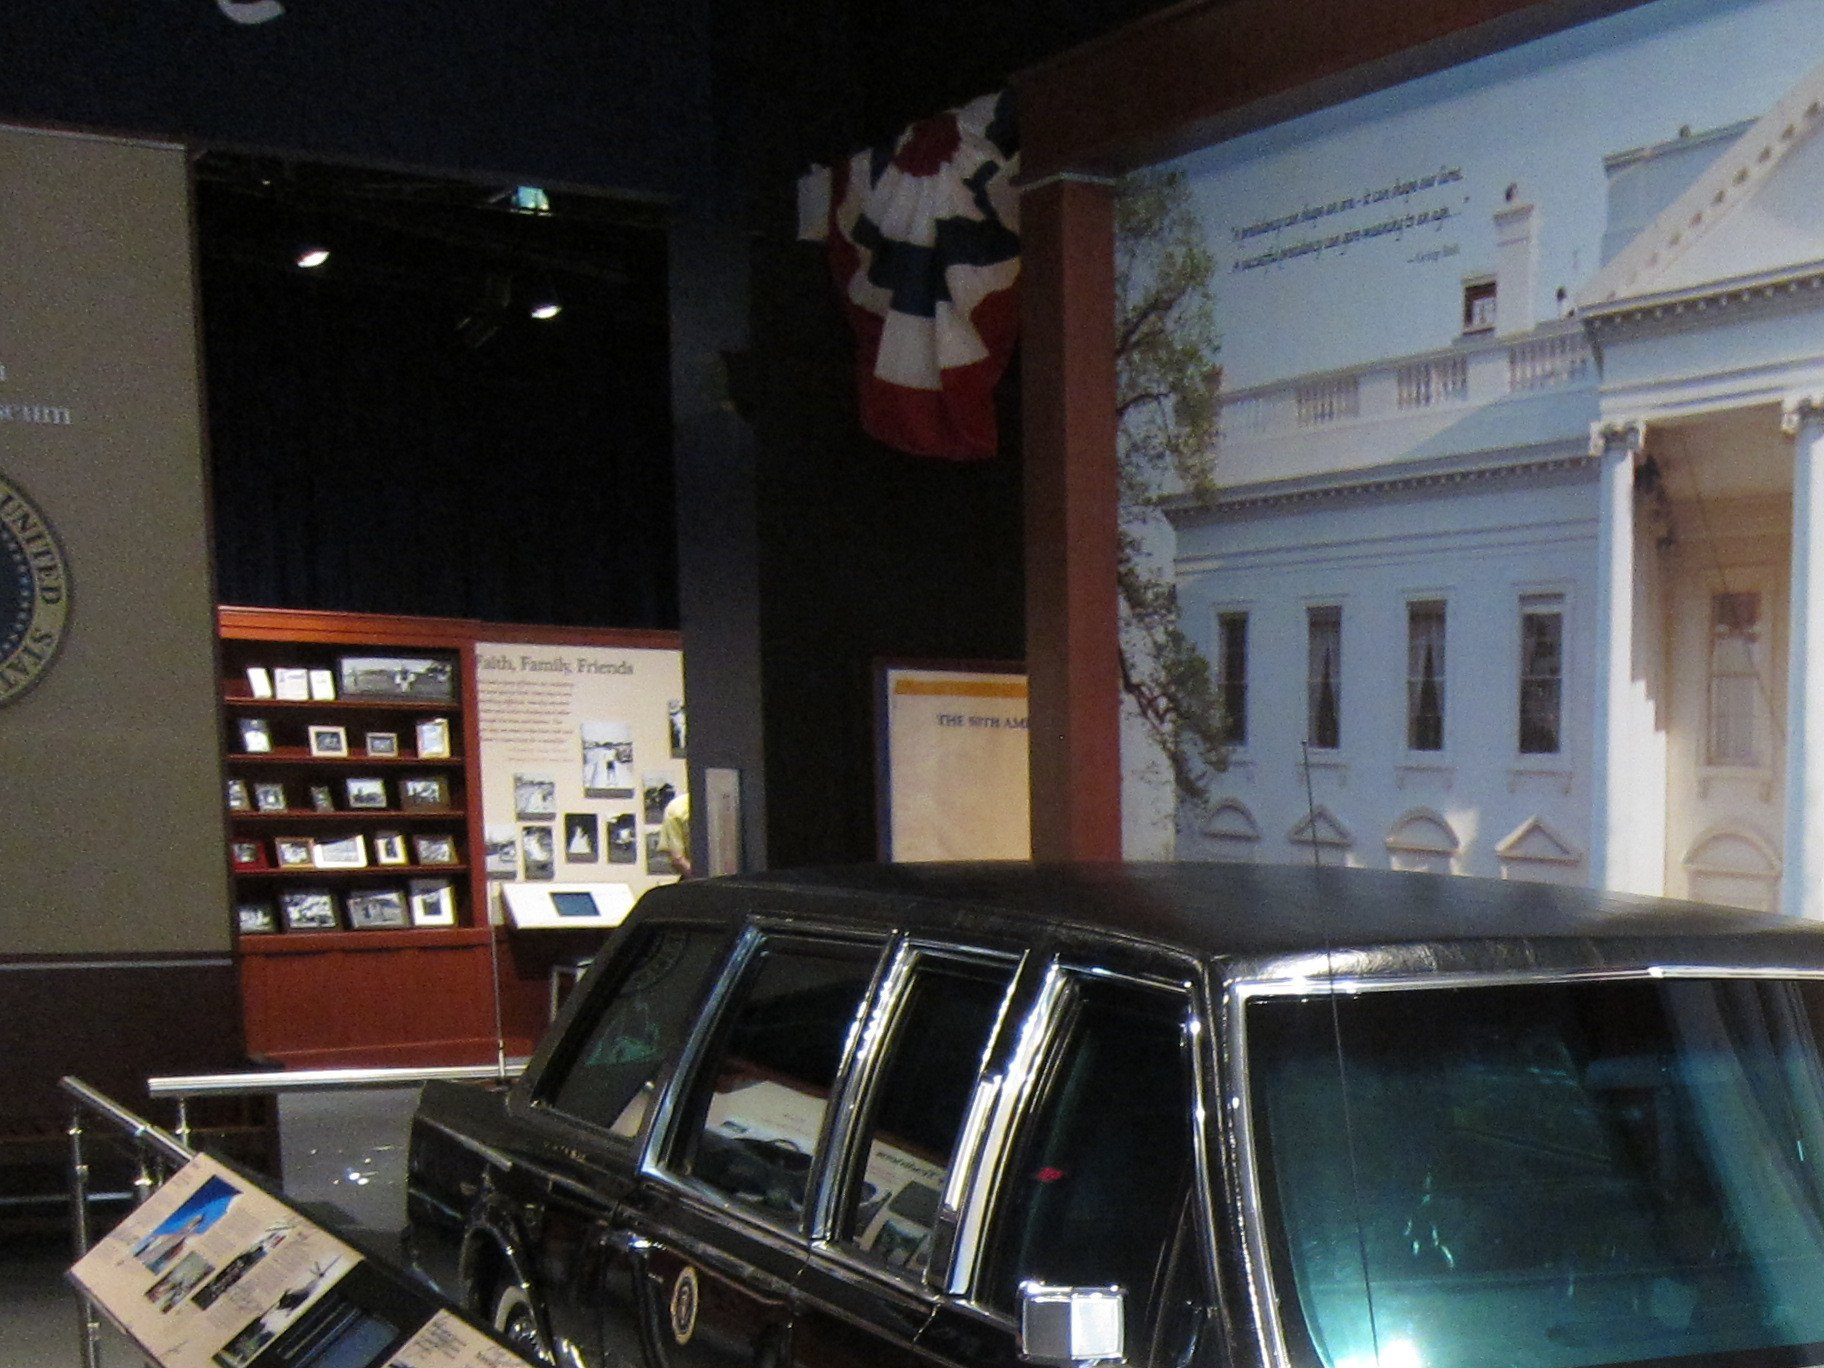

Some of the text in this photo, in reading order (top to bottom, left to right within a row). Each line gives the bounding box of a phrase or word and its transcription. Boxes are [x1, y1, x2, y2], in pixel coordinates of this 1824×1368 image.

[0, 494, 61, 605] UNITED
[520, 656, 573, 676] Family,
[576, 657, 634, 675] Friends
[936, 714, 964, 726] THE
